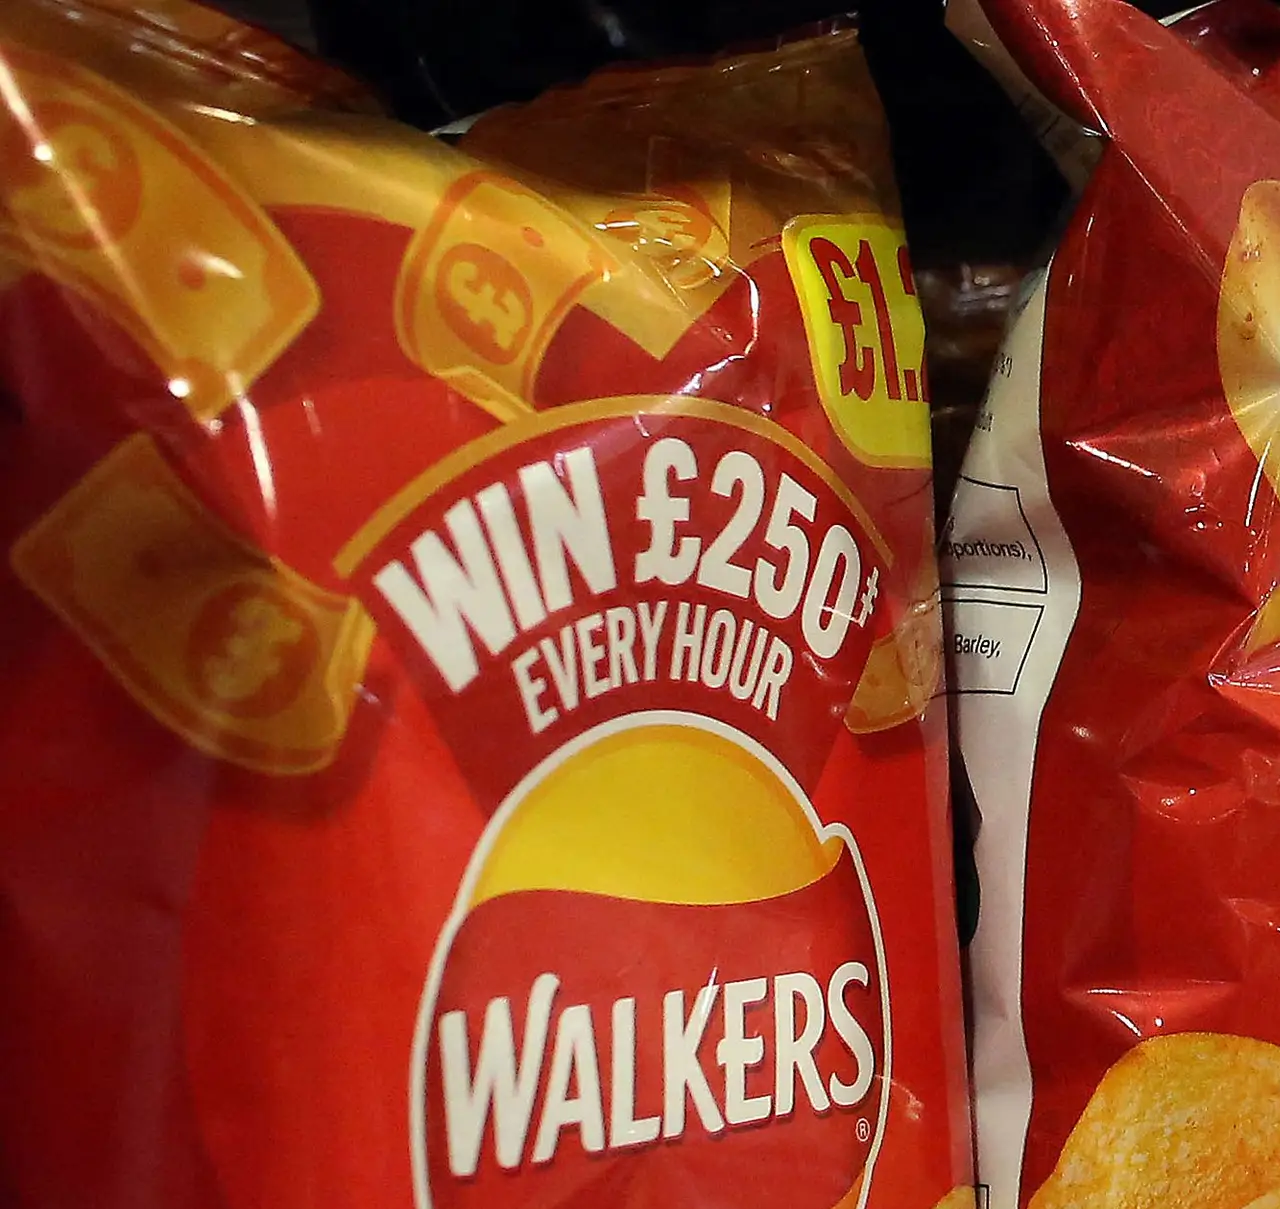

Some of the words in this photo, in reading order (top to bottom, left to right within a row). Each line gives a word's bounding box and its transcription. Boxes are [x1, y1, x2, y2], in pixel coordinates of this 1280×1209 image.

[810, 237, 930, 402] £1.
[373, 446, 617, 693] WIN
[954, 633, 1001, 659] Barley,
[512, 601, 667, 735] EVERY
[670, 603, 794, 702] HOUR
[438, 960, 875, 1178] WALKERS
